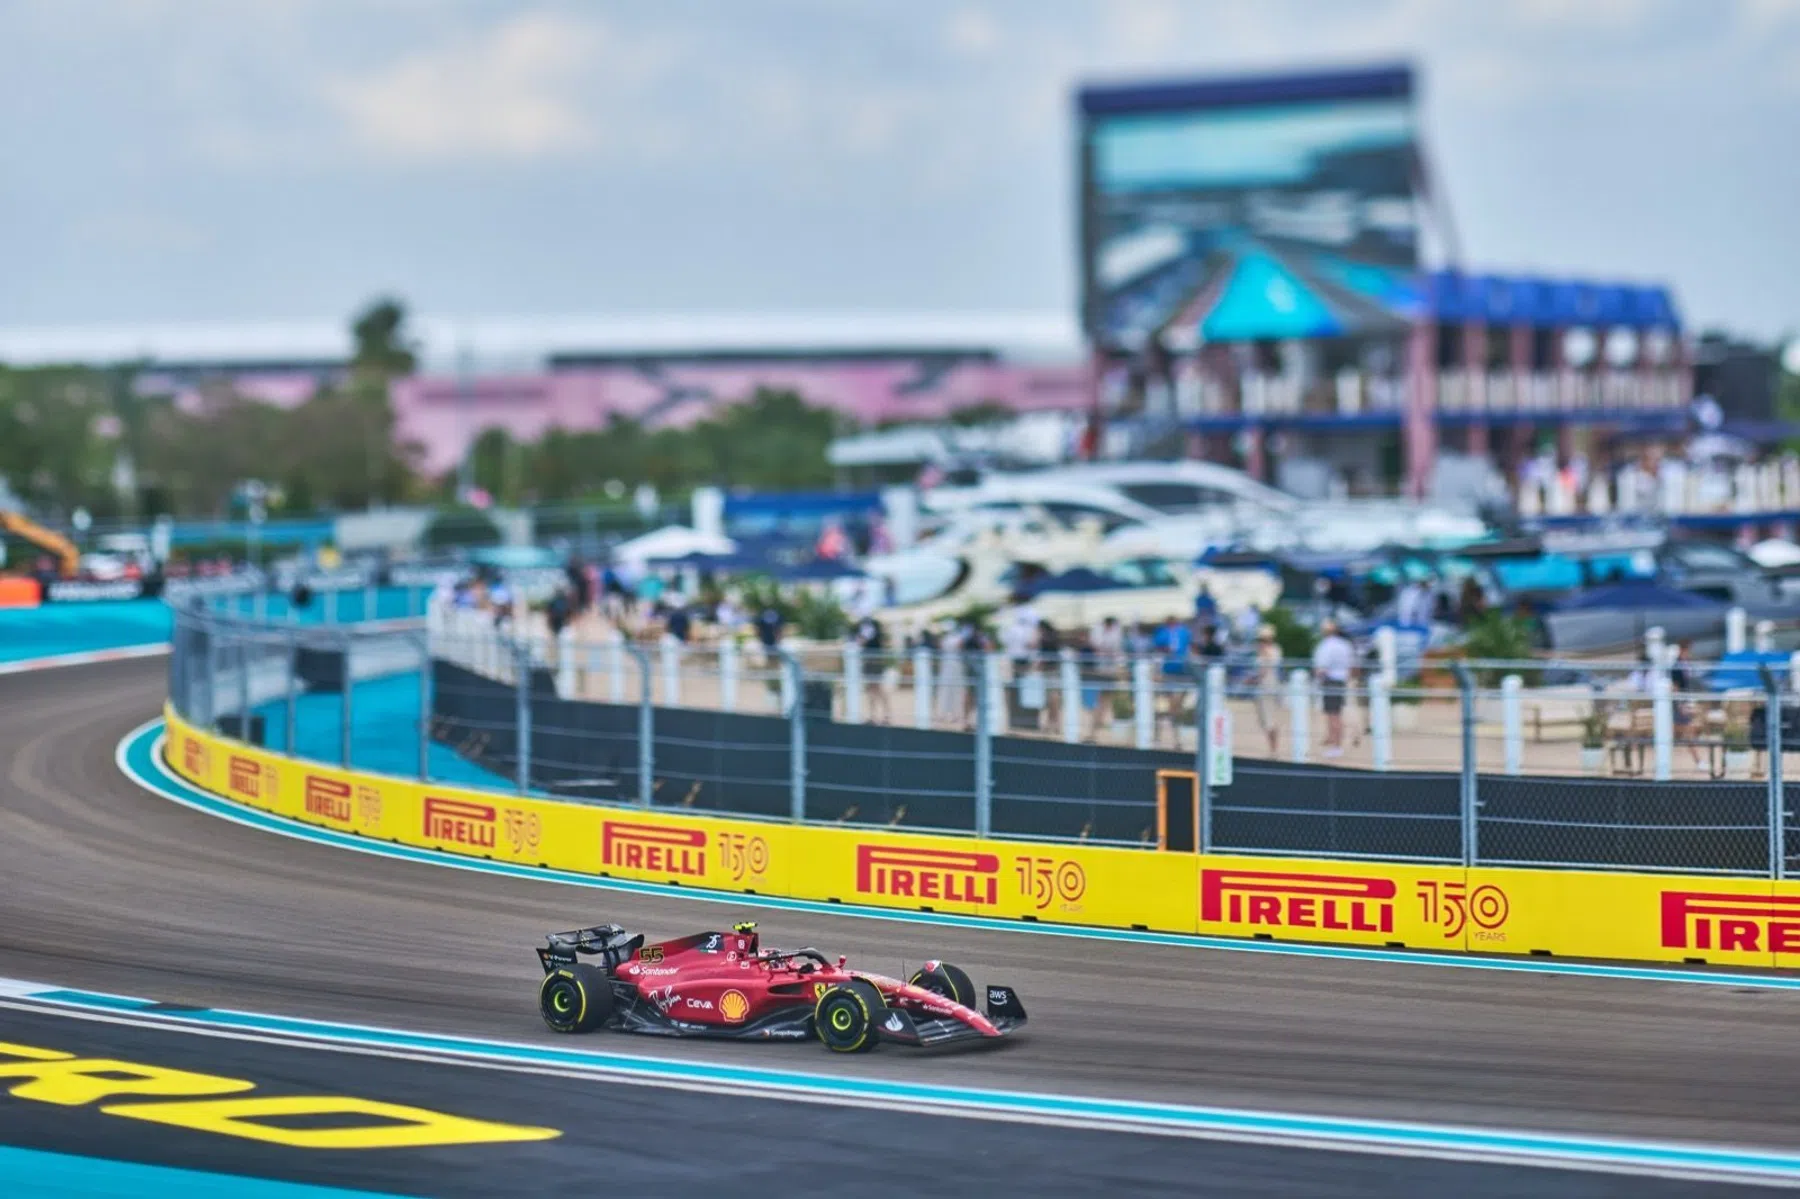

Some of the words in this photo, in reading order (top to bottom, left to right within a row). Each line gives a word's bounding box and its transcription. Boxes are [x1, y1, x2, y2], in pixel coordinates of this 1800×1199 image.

[305, 775, 351, 822] PIRELLI
[423, 797, 496, 848] PIRELLI
[602, 821, 707, 876] PIRELLI
[718, 832, 769, 881] 150
[857, 844, 1000, 905] PIRELLI
[1016, 857, 1086, 909] 150
[1201, 869, 1396, 933] PIRELLI
[1416, 881, 1509, 938] 150
[640, 946, 664, 963] 55
[1473, 931, 1508, 943] YEARS
[641, 966, 679, 976] Santander
[989, 989, 1007, 999] aws
